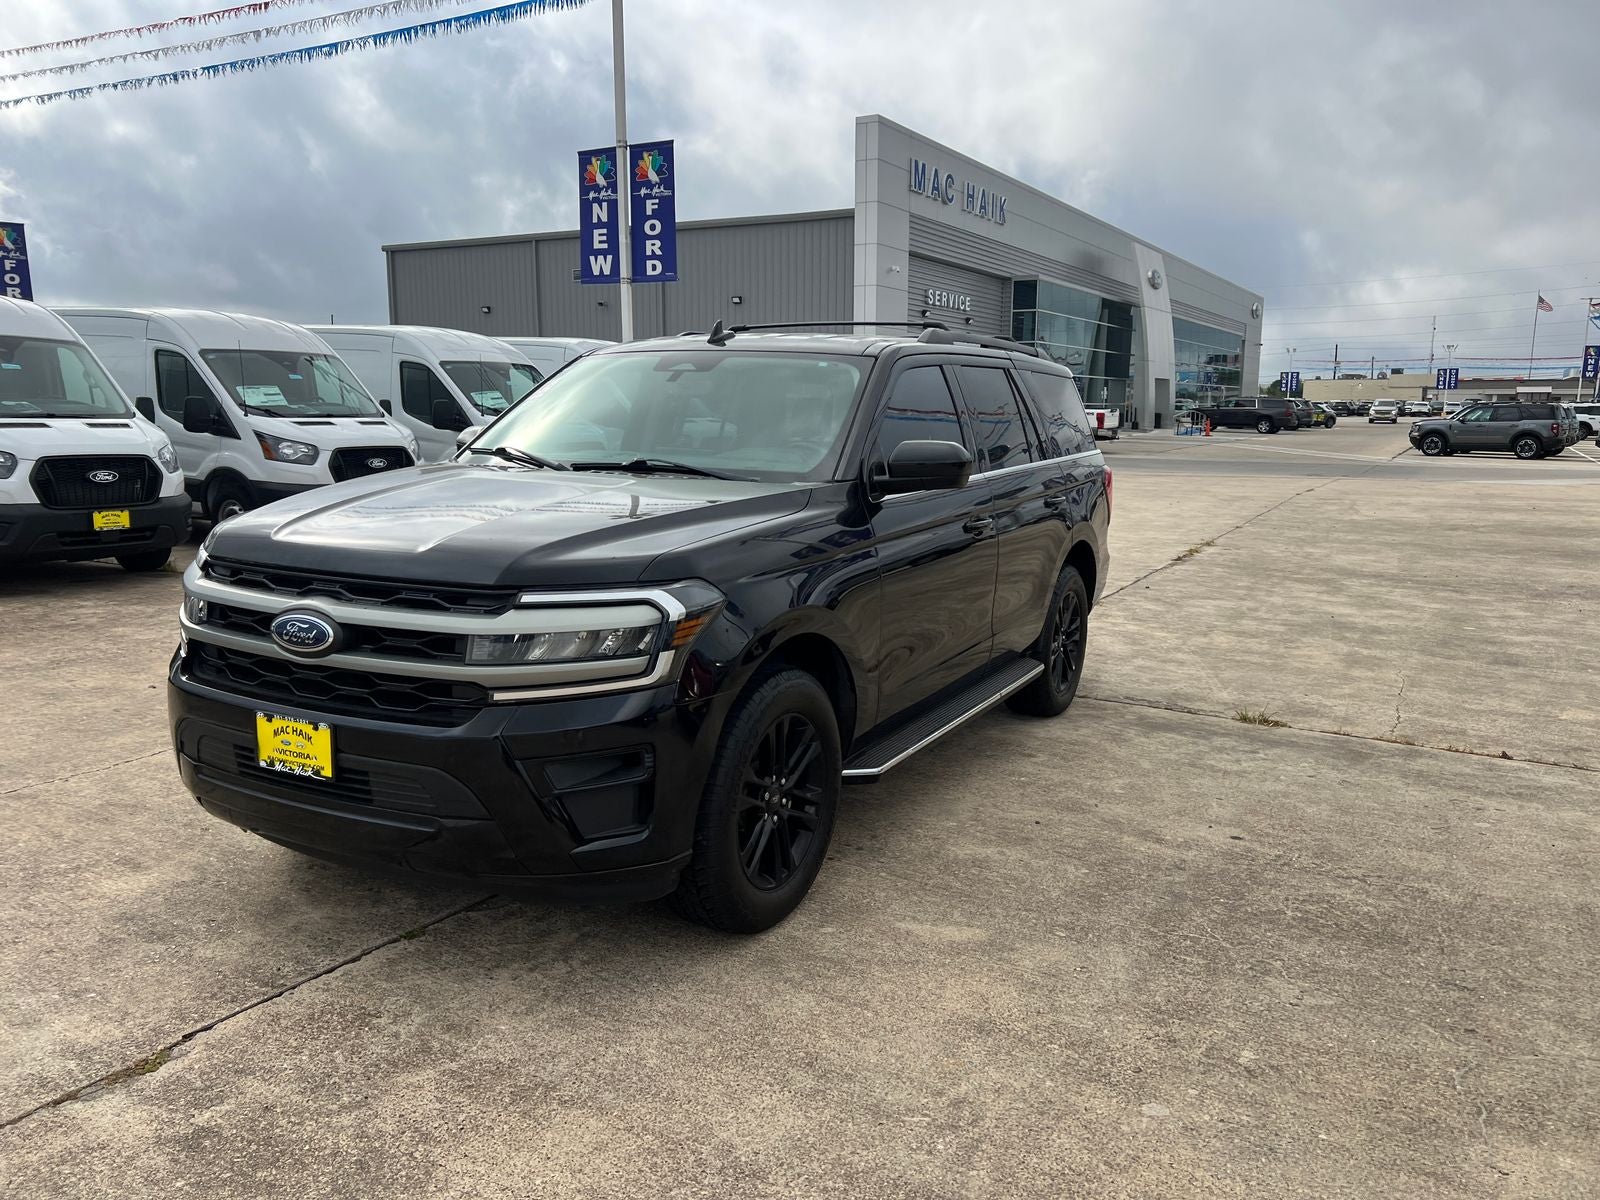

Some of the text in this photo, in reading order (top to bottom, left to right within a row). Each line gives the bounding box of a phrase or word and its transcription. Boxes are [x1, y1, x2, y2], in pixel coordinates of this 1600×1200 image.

[911, 159, 1008, 225] MAC HAIK
[589, 202, 613, 276] NEW
[644, 199, 663, 276] FORD
[928, 289, 971, 311] SERVICE
[1585, 359, 1595, 377] NEW
[273, 725, 313, 745] MAC HAIK
[271, 762, 293, 774] Mac
